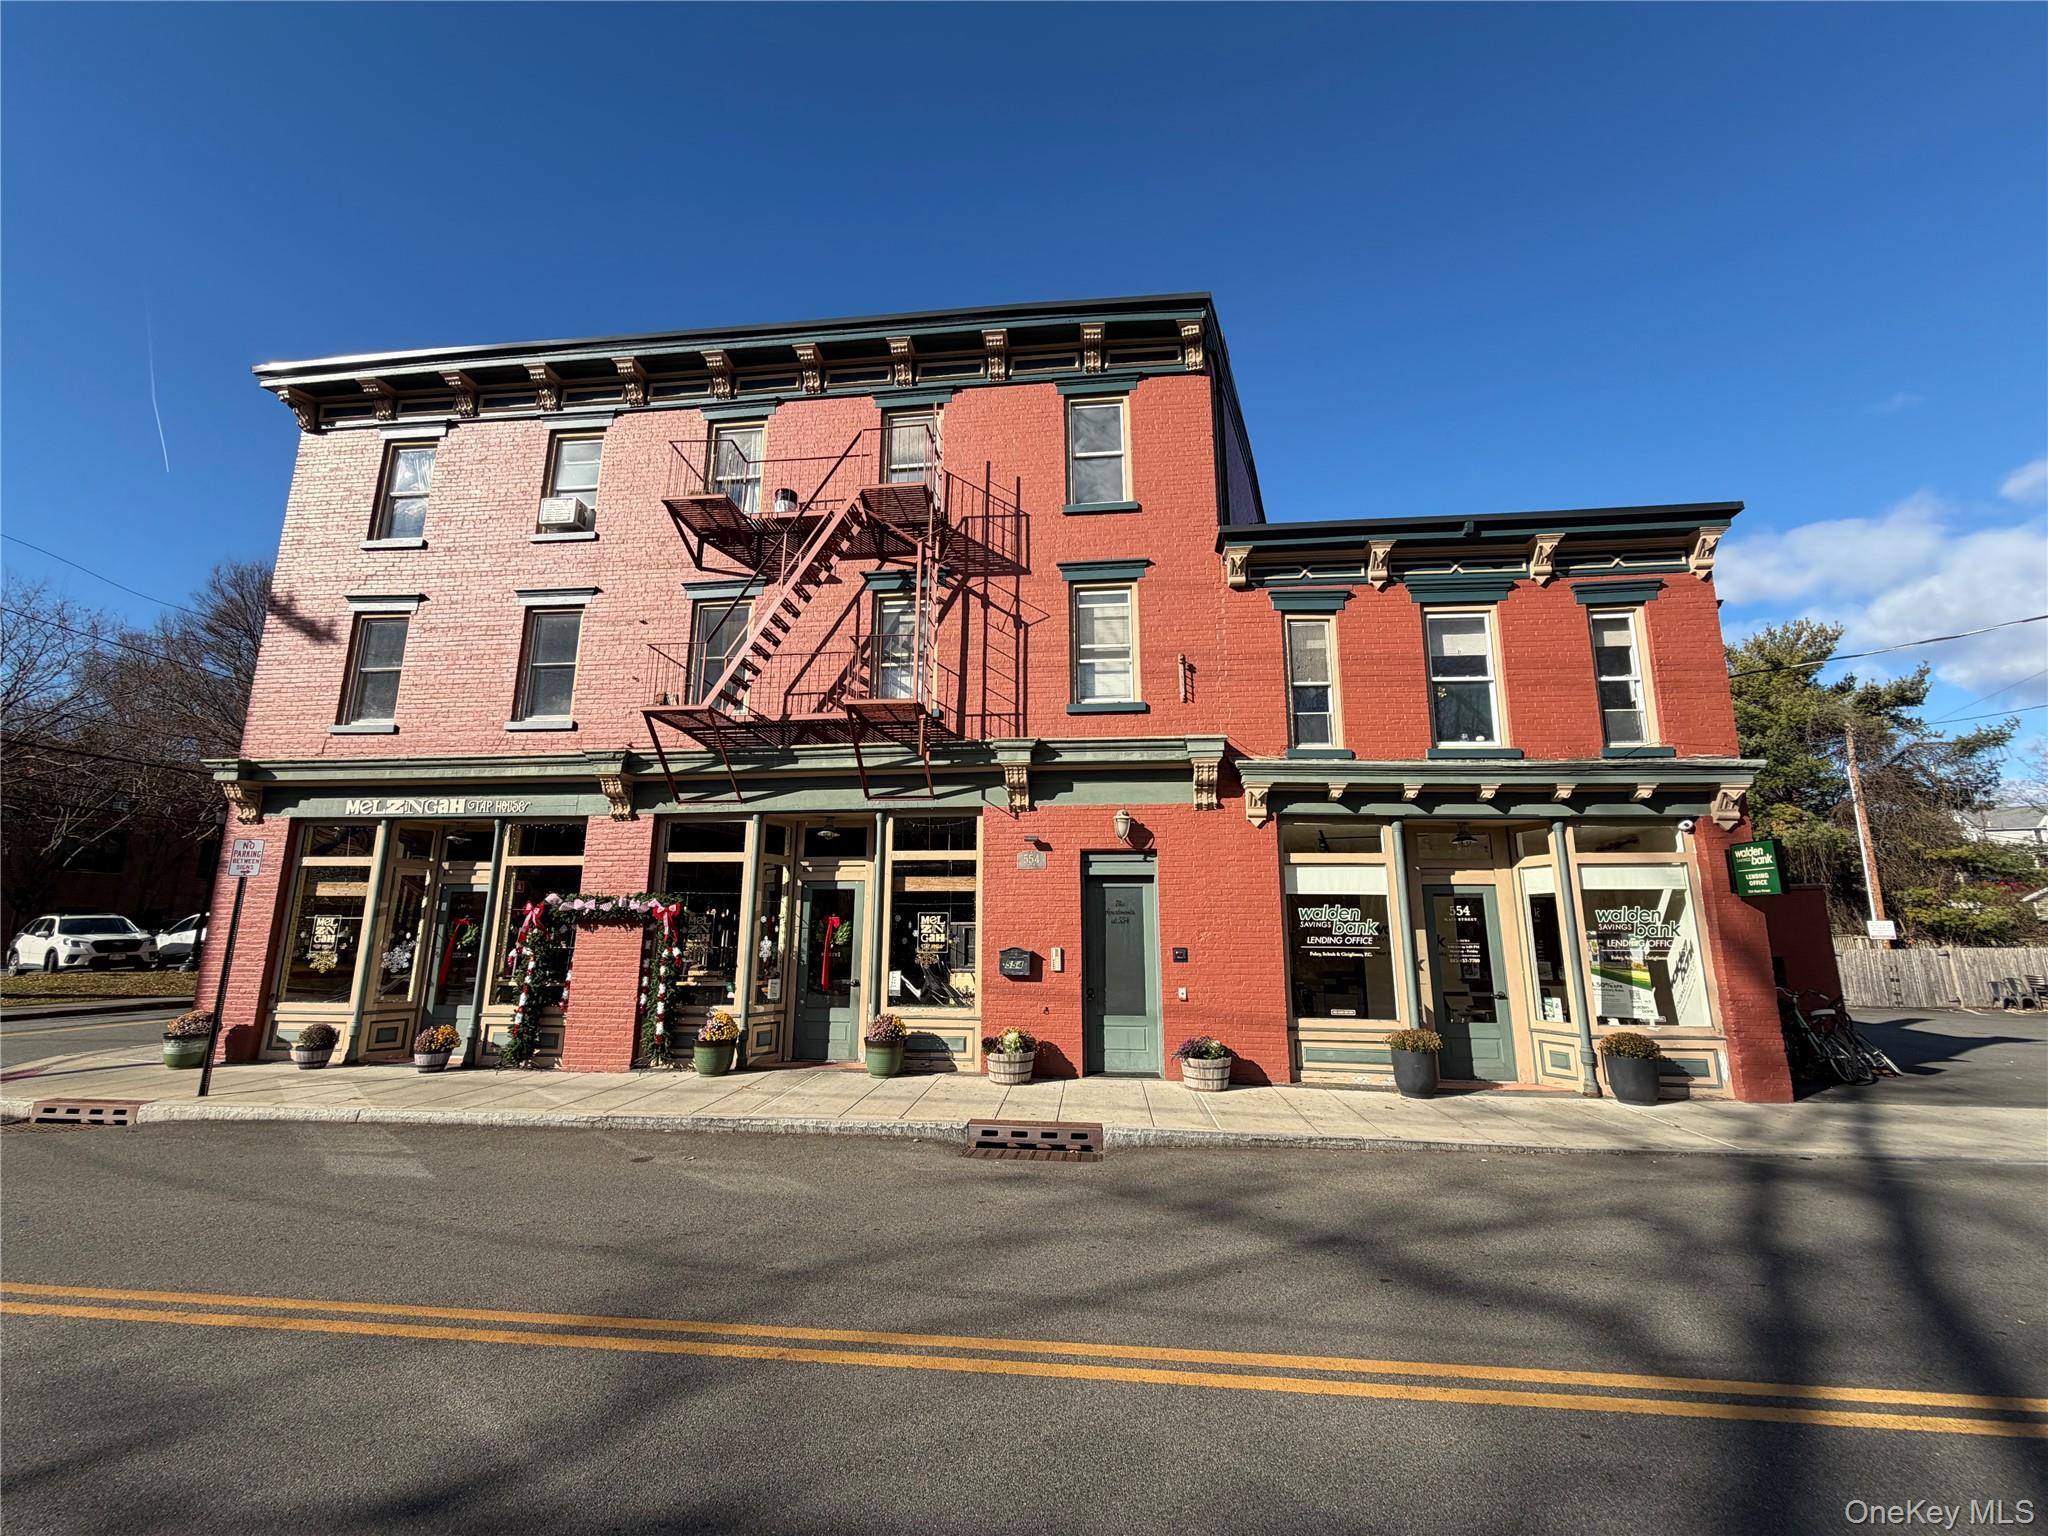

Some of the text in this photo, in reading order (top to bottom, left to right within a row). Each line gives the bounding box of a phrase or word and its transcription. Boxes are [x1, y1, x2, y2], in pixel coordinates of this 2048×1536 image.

[468, 800, 493, 813] TAP
[243, 840, 256, 850] NO
[234, 850, 262, 858] PARKING
[1735, 847, 1763, 857] walden
[1023, 853, 1040, 864] 554
[1751, 854, 1773, 865] bank
[1298, 904, 1361, 921] walden
[1449, 905, 1471, 916] 554
[1595, 905, 1662, 923] walden
[1332, 918, 1380, 936] bank
[1598, 920, 1682, 938] SAVINGS bank
[1306, 936, 1373, 945] LENDING OFFICE
[1648, 939, 1674, 948] OFFIC
[1004, 960, 1025, 969] 554
